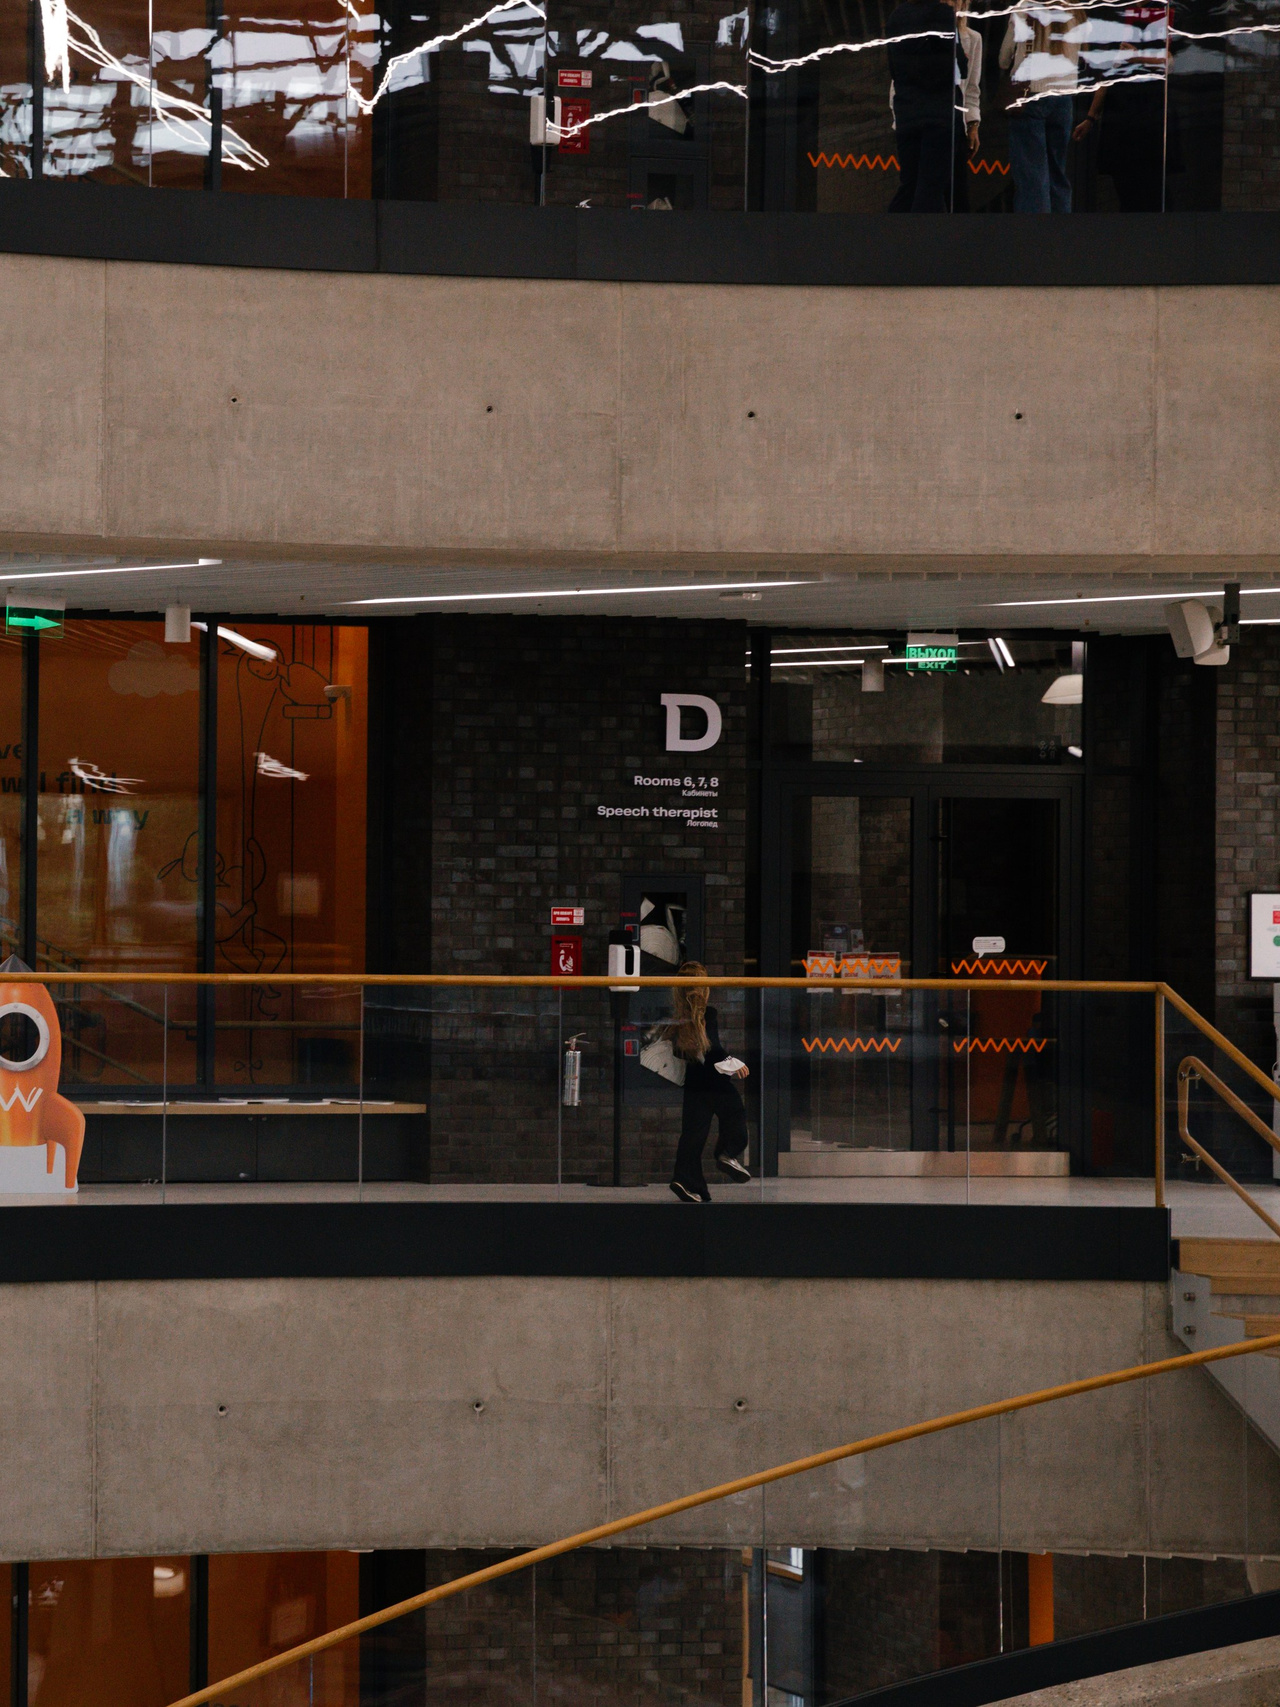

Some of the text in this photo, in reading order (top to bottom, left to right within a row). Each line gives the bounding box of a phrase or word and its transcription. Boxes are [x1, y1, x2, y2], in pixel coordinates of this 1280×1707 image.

[909, 647, 956, 664] ВЫХОД
[918, 661, 947, 669] EXIT
[660, 693, 722, 752] D
[634, 775, 719, 789] Rooms 6, 7, 8
[682, 789, 718, 797] Кабинеты
[597, 805, 719, 819] Speech therapist
[686, 820, 718, 828] Логопед
